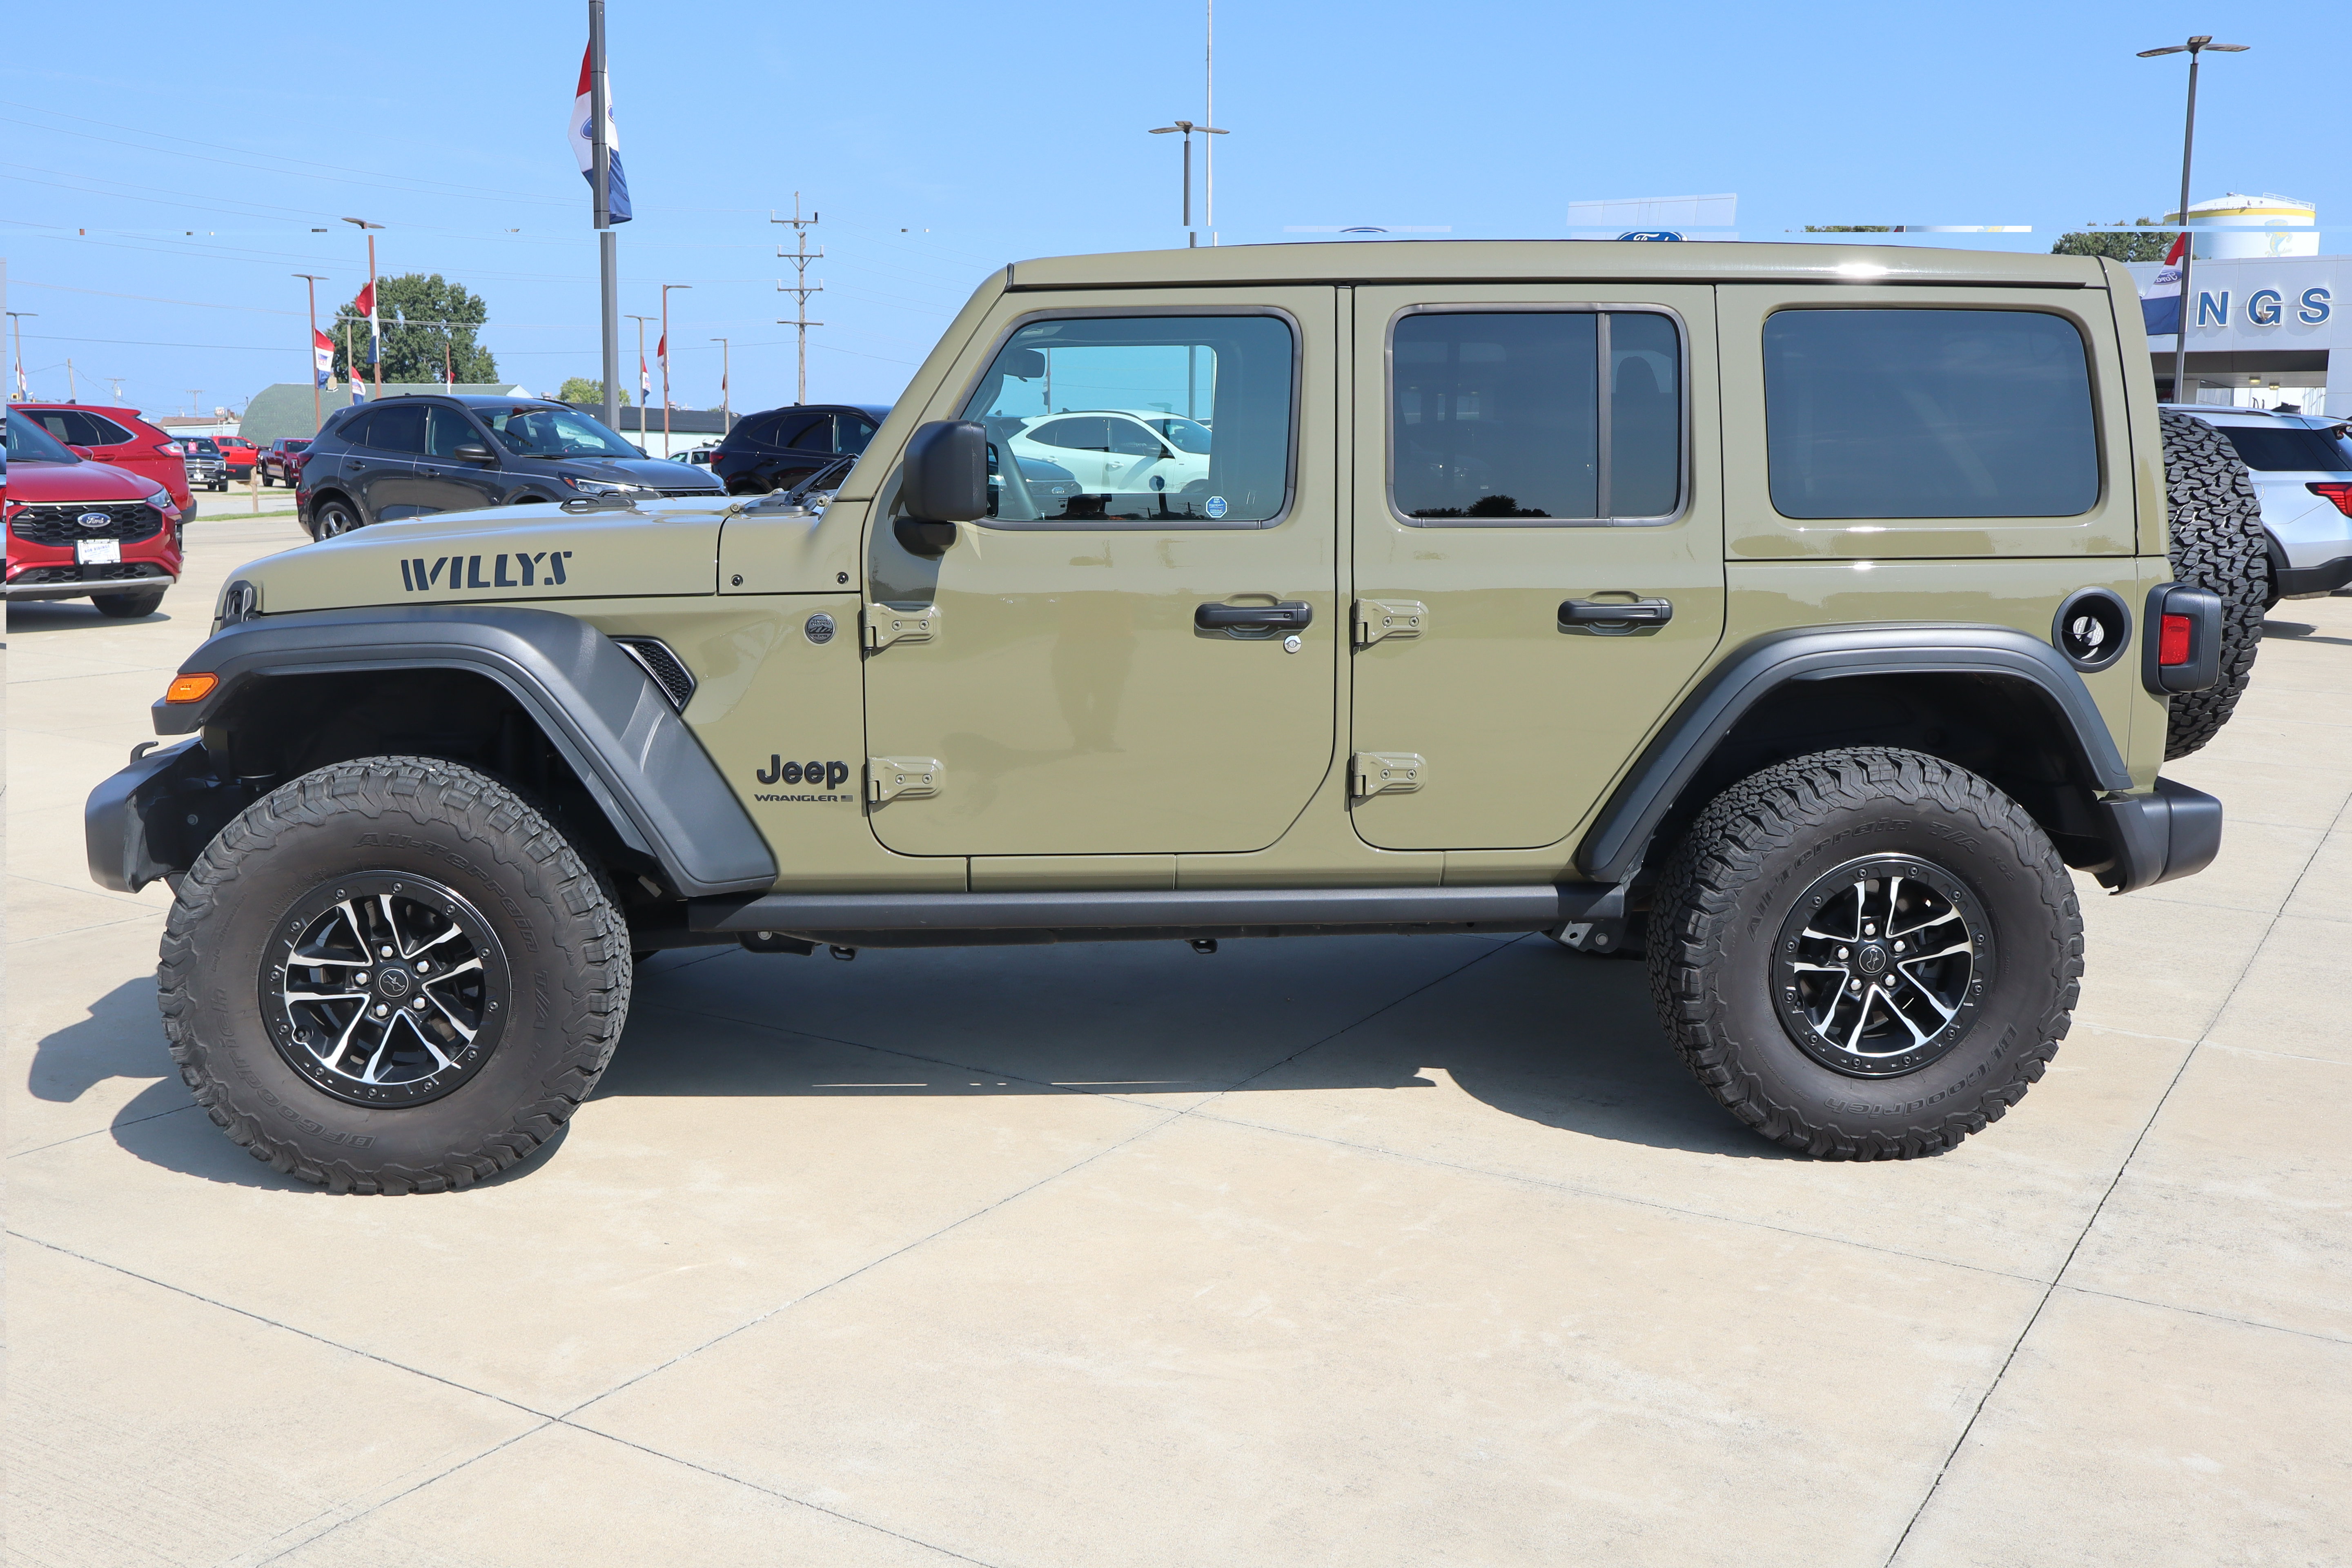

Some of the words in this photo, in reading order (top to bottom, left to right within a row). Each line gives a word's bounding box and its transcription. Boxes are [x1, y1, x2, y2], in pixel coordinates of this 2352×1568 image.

[2196, 287, 2332, 327] NGS
[86, 516, 105, 524] Ford
[401, 551, 572, 591] WILLYS
[757, 754, 849, 790] Jeep
